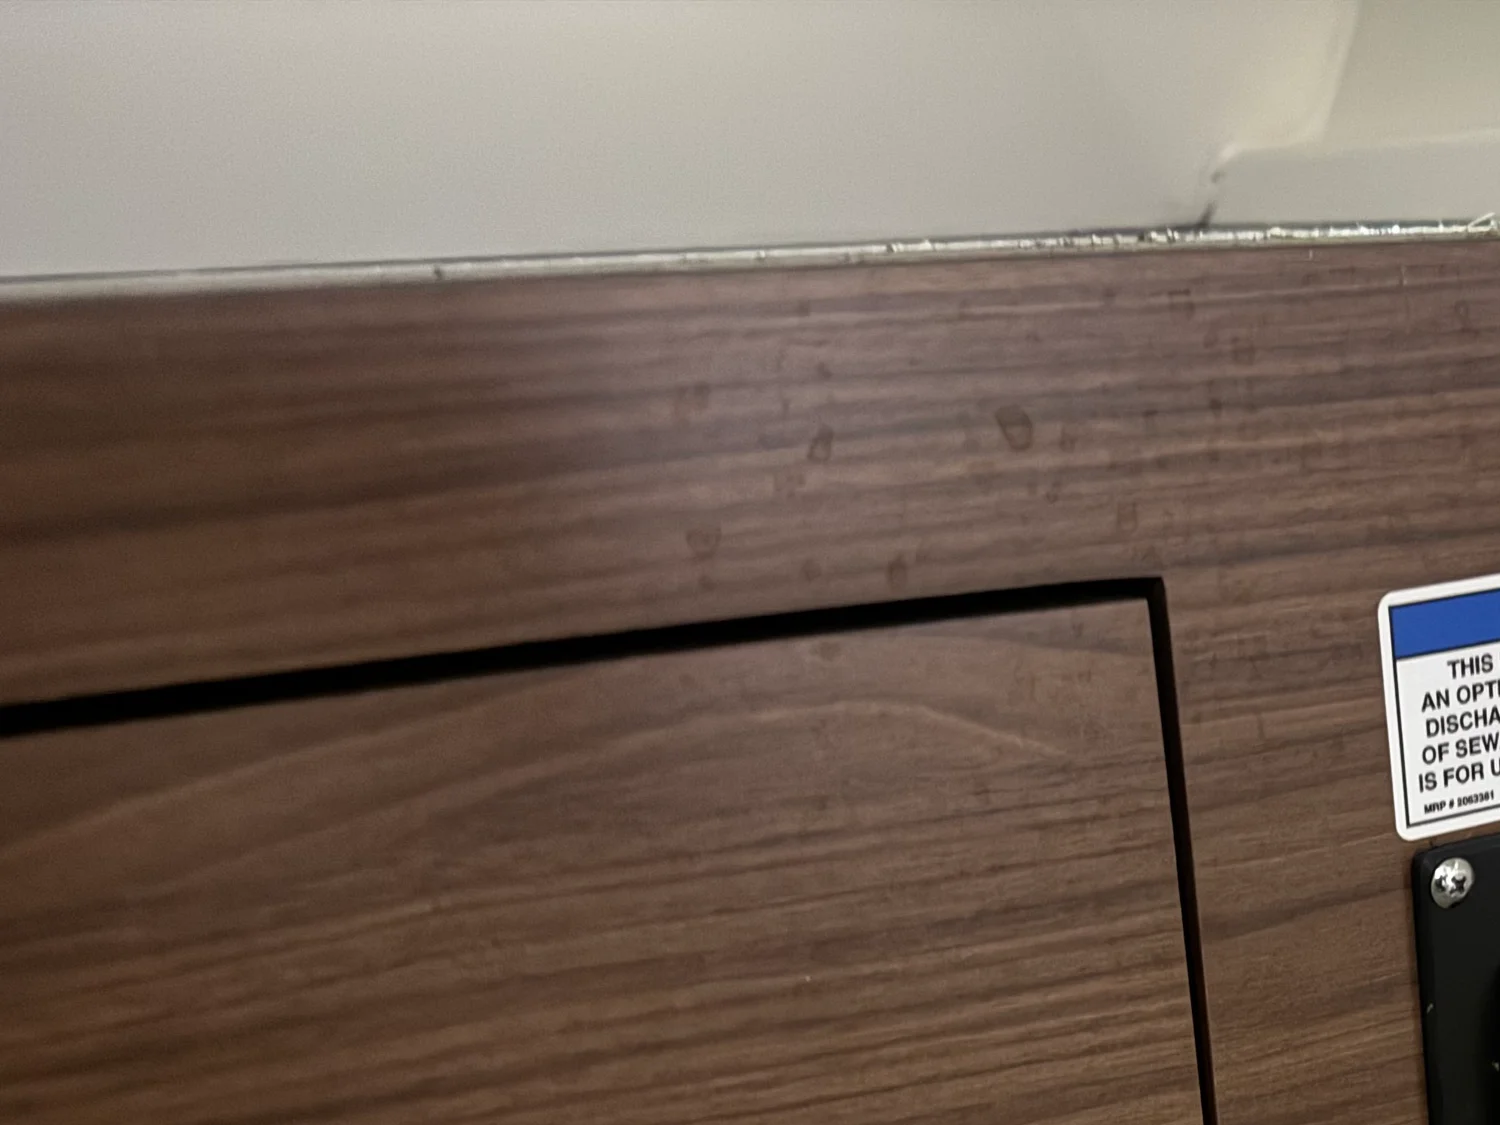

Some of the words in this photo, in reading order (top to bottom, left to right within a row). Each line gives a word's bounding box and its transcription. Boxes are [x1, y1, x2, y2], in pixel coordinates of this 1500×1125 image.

[1448, 657, 1494, 679] THIS
[1422, 689, 1450, 713] AN
[1423, 744, 1450, 765] OF
[1419, 771, 1438, 793] IS
[1444, 763, 1485, 788] FOR
[1424, 800, 1446, 814] MRP
[1449, 799, 1455, 809] #
